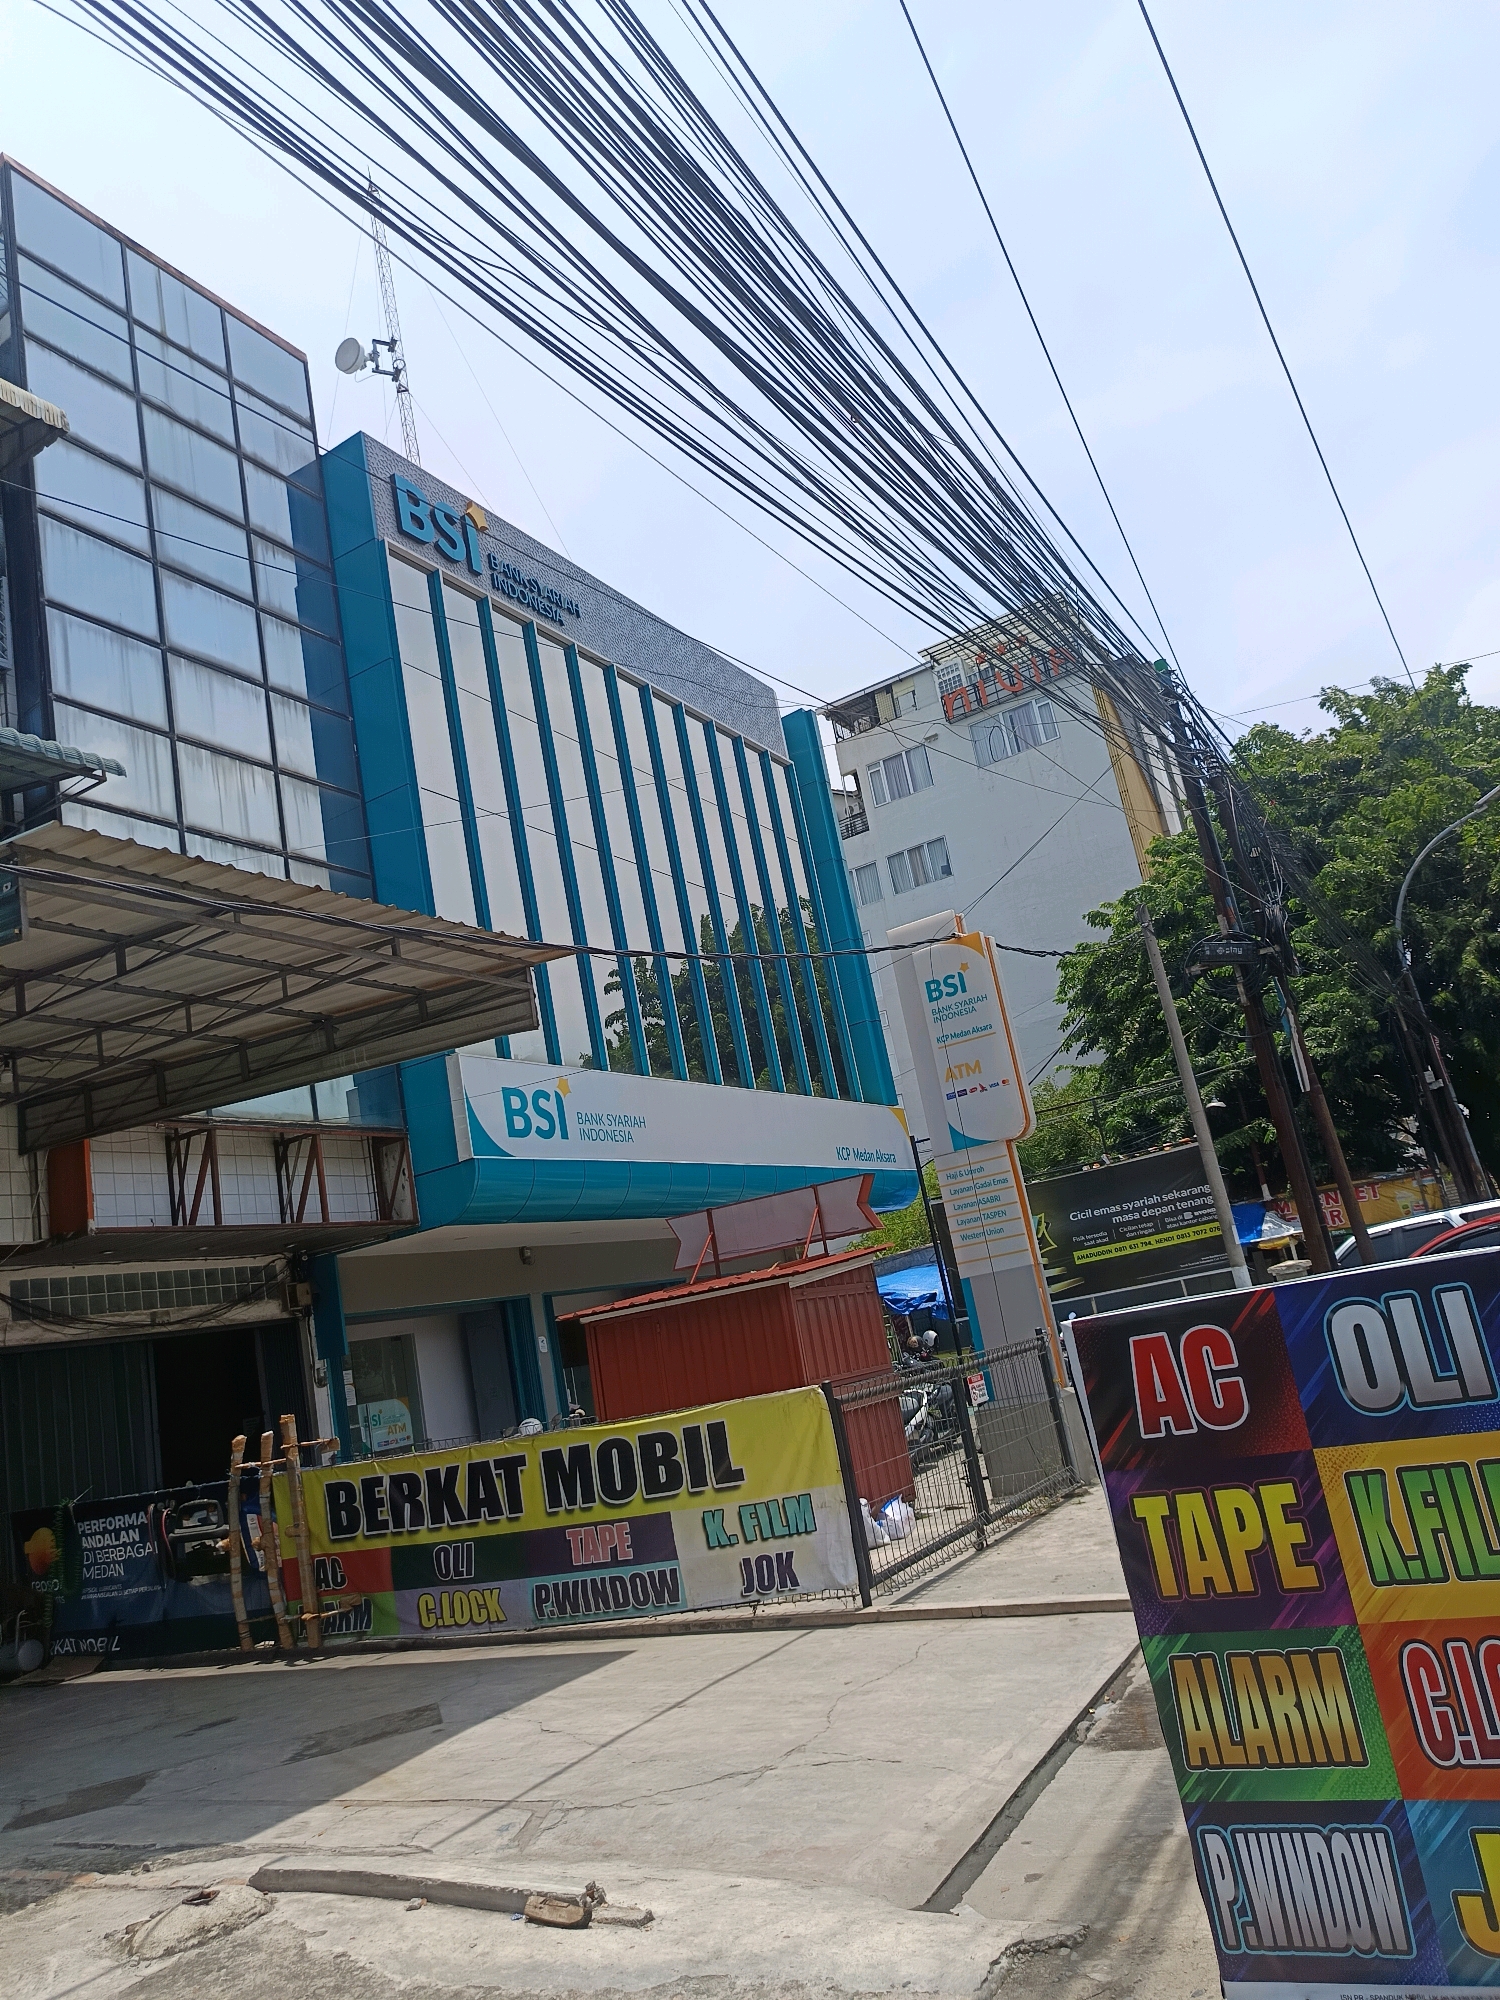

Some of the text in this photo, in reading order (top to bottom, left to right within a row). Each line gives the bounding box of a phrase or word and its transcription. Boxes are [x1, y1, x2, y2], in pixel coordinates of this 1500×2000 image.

[390, 473, 487, 576] BSI
[488, 553, 580, 618] BANK SYARIAH
[491, 573, 565, 626] INDONESIA
[925, 964, 969, 1003] BSI
[931, 994, 988, 1016] BANK SYARIAH
[933, 1005, 977, 1024] INDONESIA
[936, 1023, 993, 1044] KCP Medan Aksara
[945, 1059, 982, 1083] ATM
[502, 1080, 570, 1140] BSI
[576, 1112, 647, 1129] BANK SYARIAH
[579, 1128, 634, 1143] INDONESIA
[836, 1146, 896, 1164] KCP Medan Aksara
[945, 1166, 985, 1181] Haji & Umroh
[950, 1177, 1009, 1196] Layanan Gadai Emas
[953, 1194, 1001, 1211] Layanan ASABRI
[1069, 1184, 1212, 1222] Cicil emas syariah sekarang
[1112, 1195, 1214, 1224] masa depan tenang
[956, 1210, 1007, 1226] Layanan TASPEN
[1119, 1222, 1154, 1233] Cicilan tetap
[960, 1226, 1005, 1242] Western Union
[1137, 1227, 1156, 1236] ringan
[1328, 1287, 1496, 1412] OLI
[1129, 1323, 1249, 1440] AC
[387, 1423, 407, 1436] ATM
[324, 1420, 746, 1540] BERKAT MOBIL
[77, 1511, 148, 1535] PERFORMA
[82, 1528, 140, 1549] ANDALAN
[566, 1521, 633, 1566] TAPE
[1131, 1480, 1322, 1599] TAPE
[84, 1541, 158, 1565] DI BERBAGAI
[433, 1542, 475, 1580] OLI
[82, 1563, 125, 1580] MEDAN
[314, 1556, 348, 1591] AC
[739, 1550, 800, 1598] JOK
[533, 1567, 682, 1620] P.WINDOW
[417, 1587, 506, 1629] C.LOCK
[1168, 1647, 1370, 1771] ALARM
[1200, 1826, 1413, 1955] P.WINDOW
